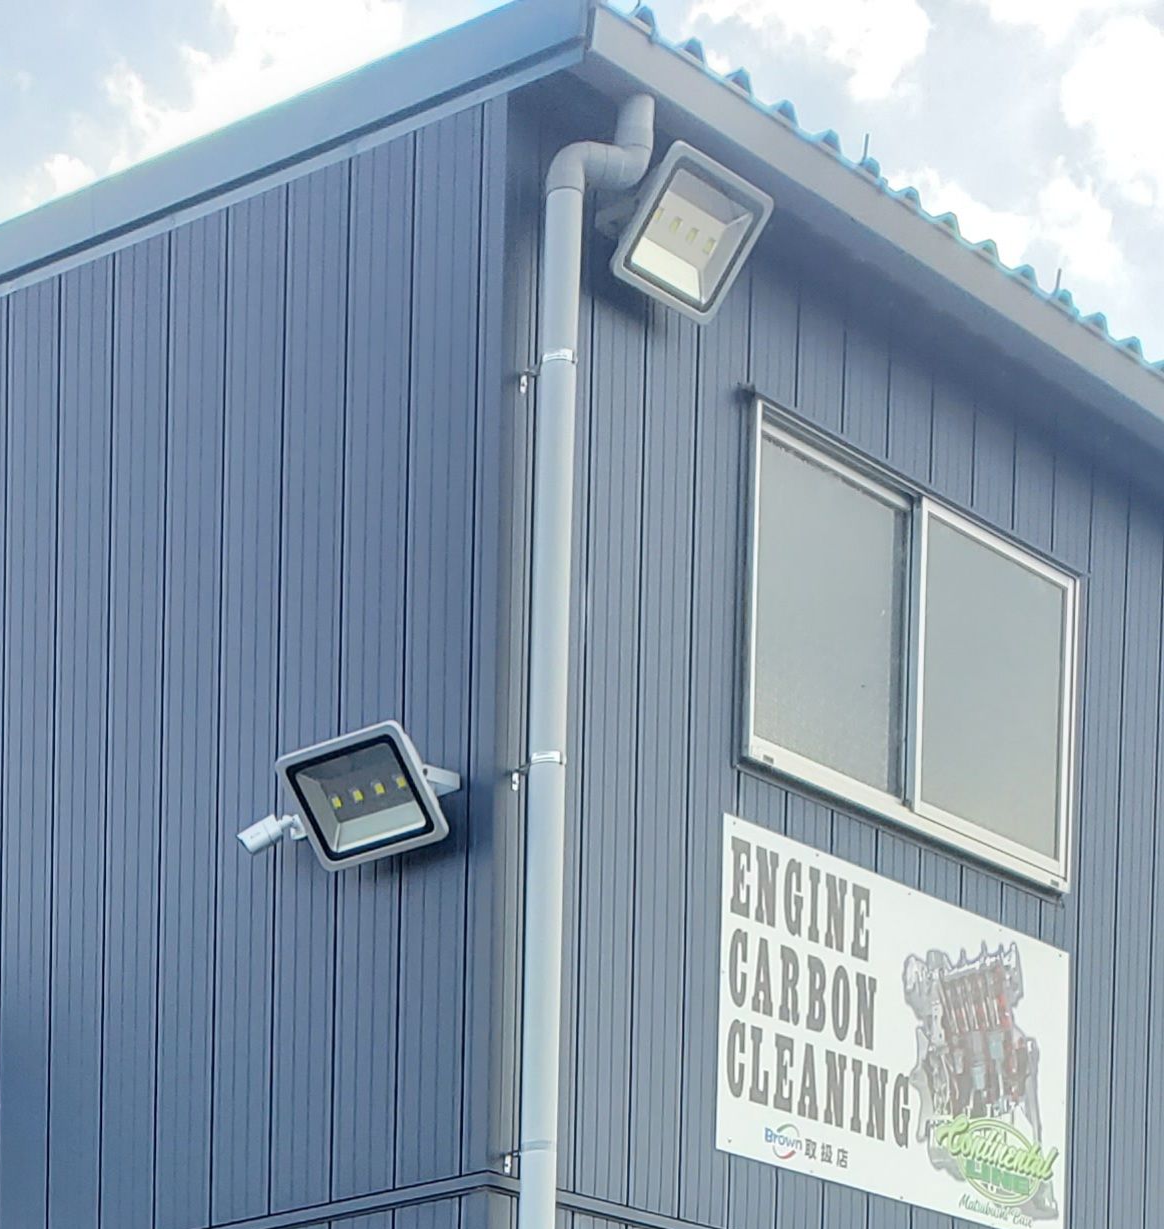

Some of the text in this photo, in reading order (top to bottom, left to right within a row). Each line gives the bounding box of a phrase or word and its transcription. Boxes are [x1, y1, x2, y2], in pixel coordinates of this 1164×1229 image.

[729, 835, 871, 962] ENGINE
[727, 928, 877, 1051] CARBON
[725, 1019, 910, 1149] CLEANING
[764, 1127, 849, 1168] Brown 取扱店
[936, 1114, 1059, 1180] Continental
